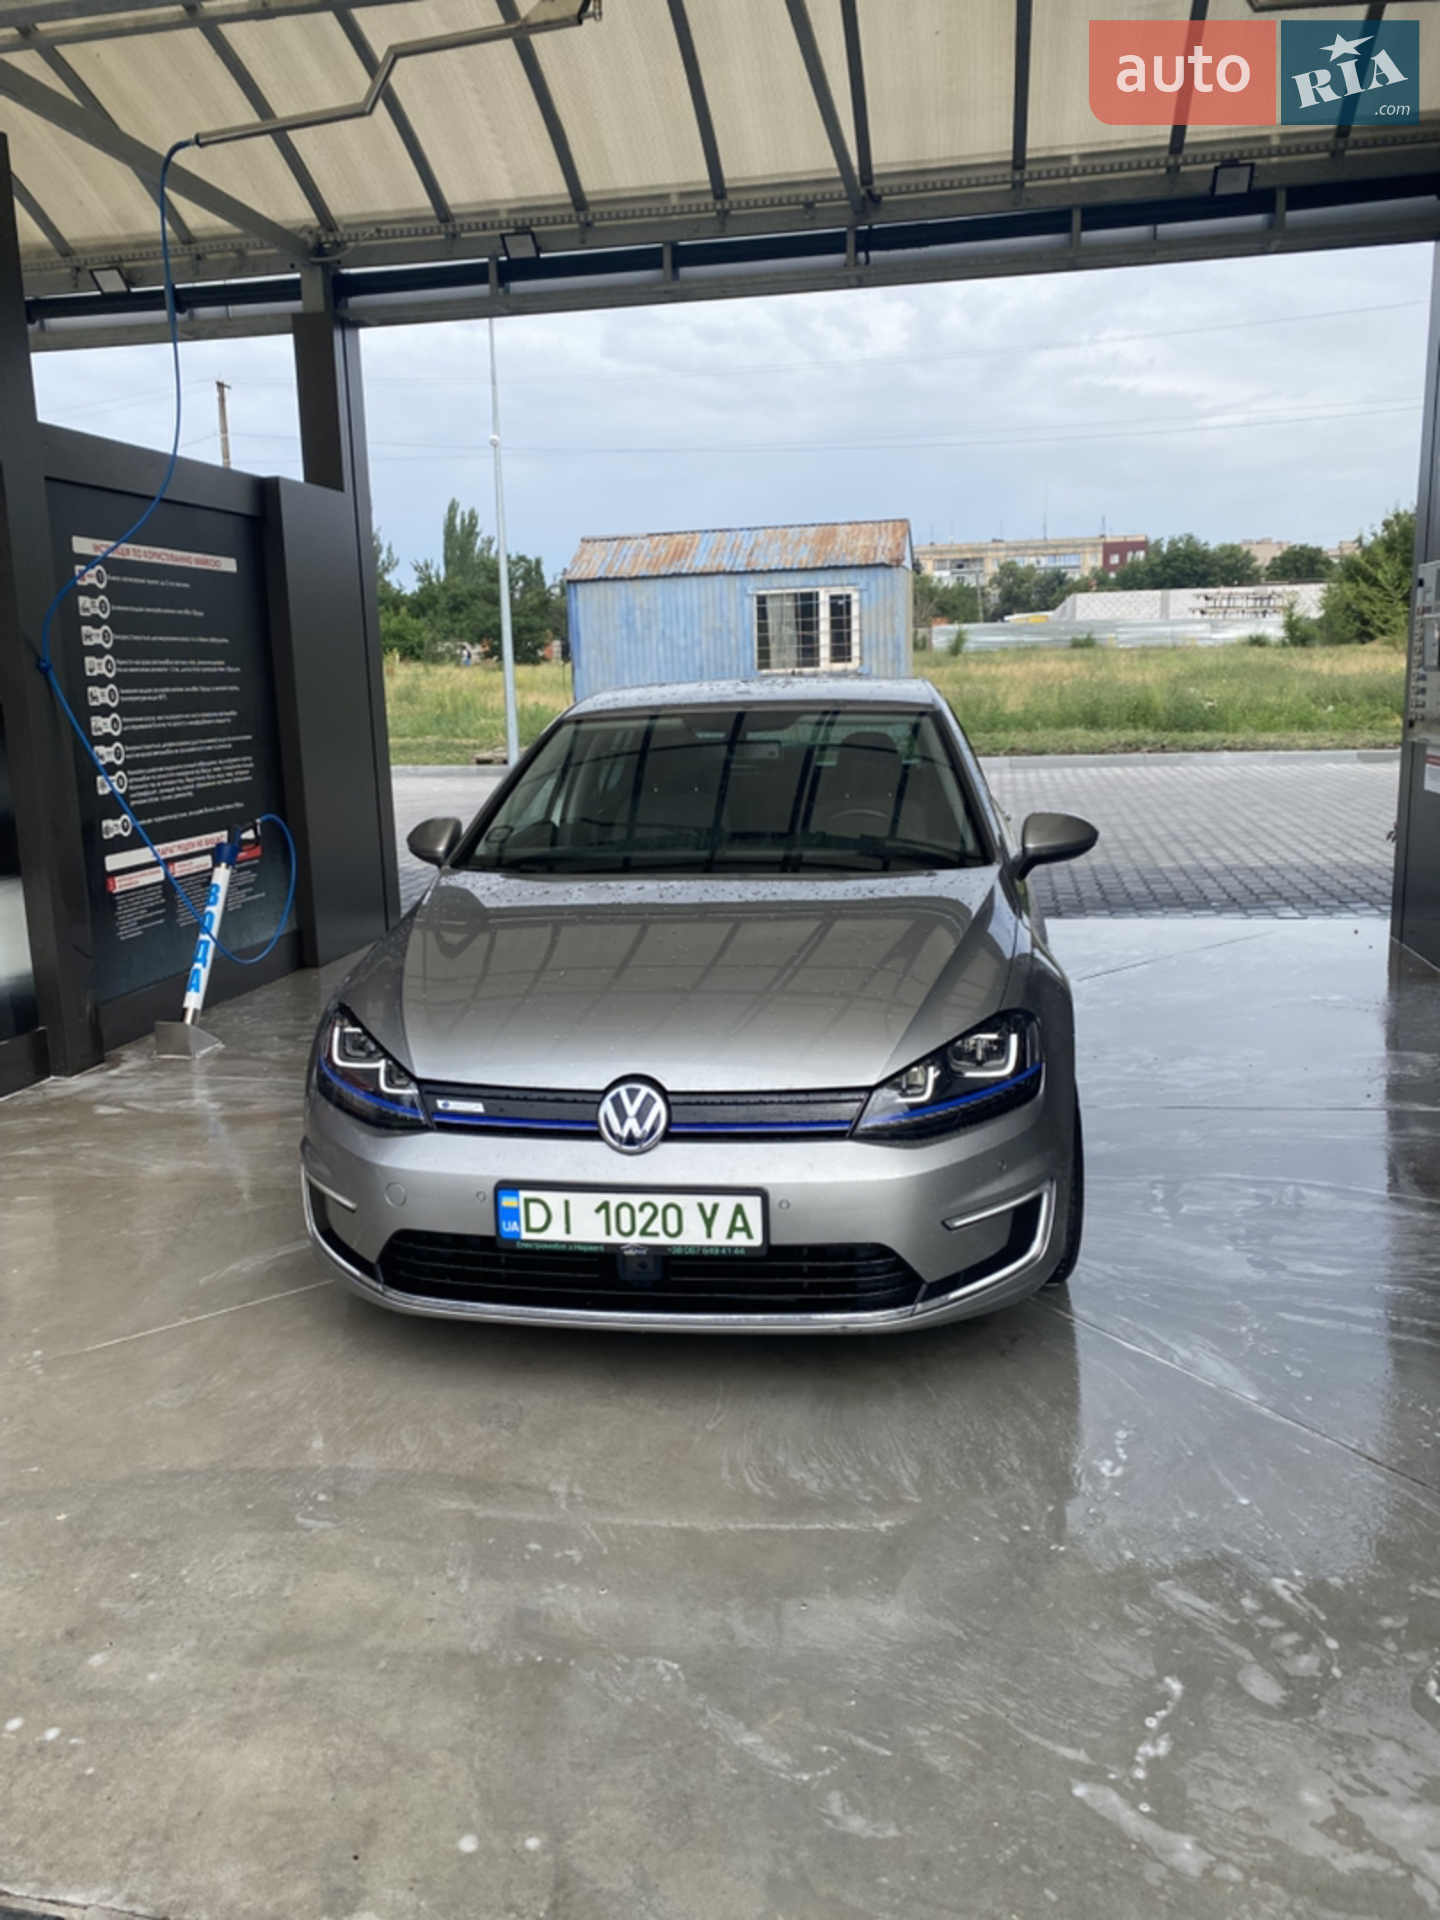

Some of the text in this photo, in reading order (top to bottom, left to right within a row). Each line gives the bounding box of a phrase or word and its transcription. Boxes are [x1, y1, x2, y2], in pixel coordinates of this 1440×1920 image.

[502, 1220, 520, 1233] UA
[523, 1197, 754, 1240] DI 1020 YA
